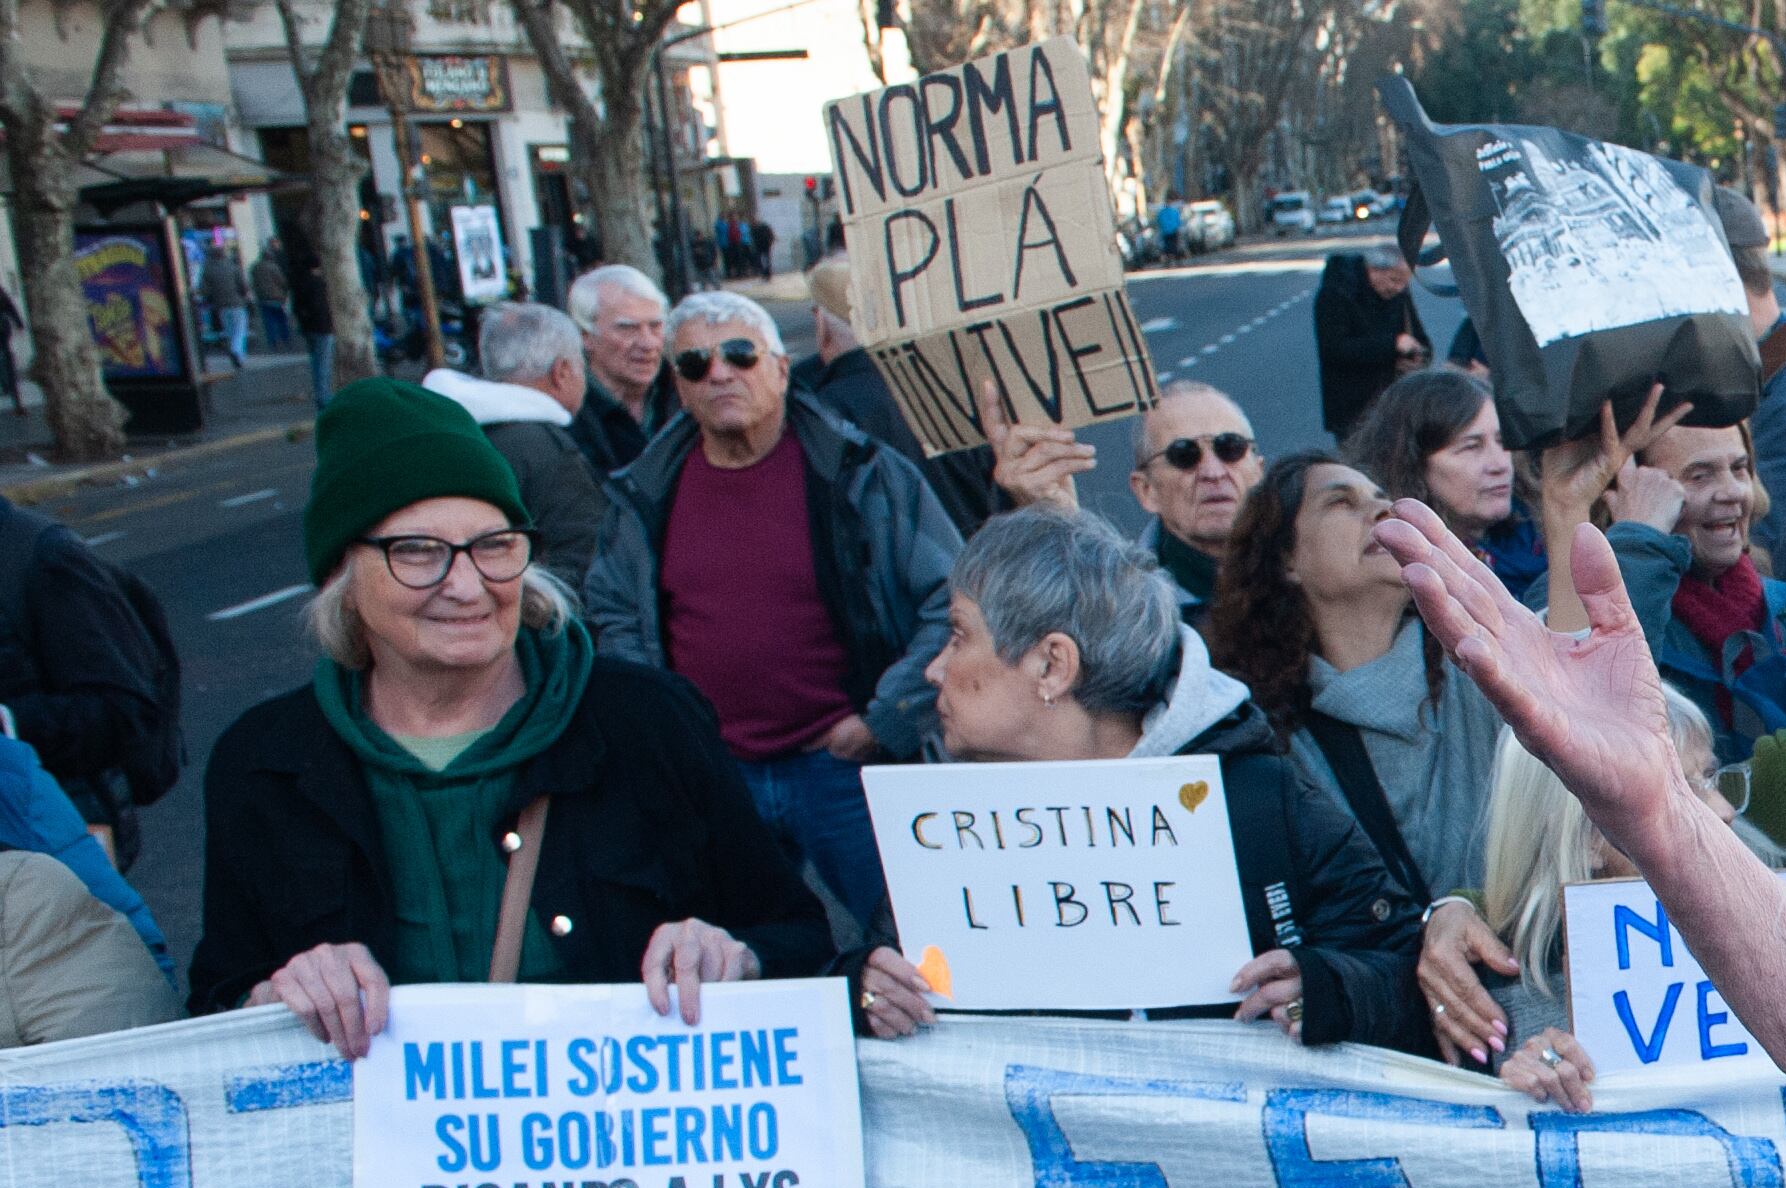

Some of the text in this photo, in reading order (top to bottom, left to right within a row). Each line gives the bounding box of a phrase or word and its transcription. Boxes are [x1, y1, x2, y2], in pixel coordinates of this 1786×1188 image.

[829, 46, 1071, 214] NORMA
[884, 173, 1078, 328] PLÁ
[911, 804, 1179, 850] CRISTINA
[963, 881, 1182, 929] LIBRE
[1614, 900, 1674, 970] N
[1612, 980, 1748, 1065] VE
[403, 1028, 804, 1101] MILEI SOSTIENE
[435, 1102, 780, 1173] SU GOBIERNO
